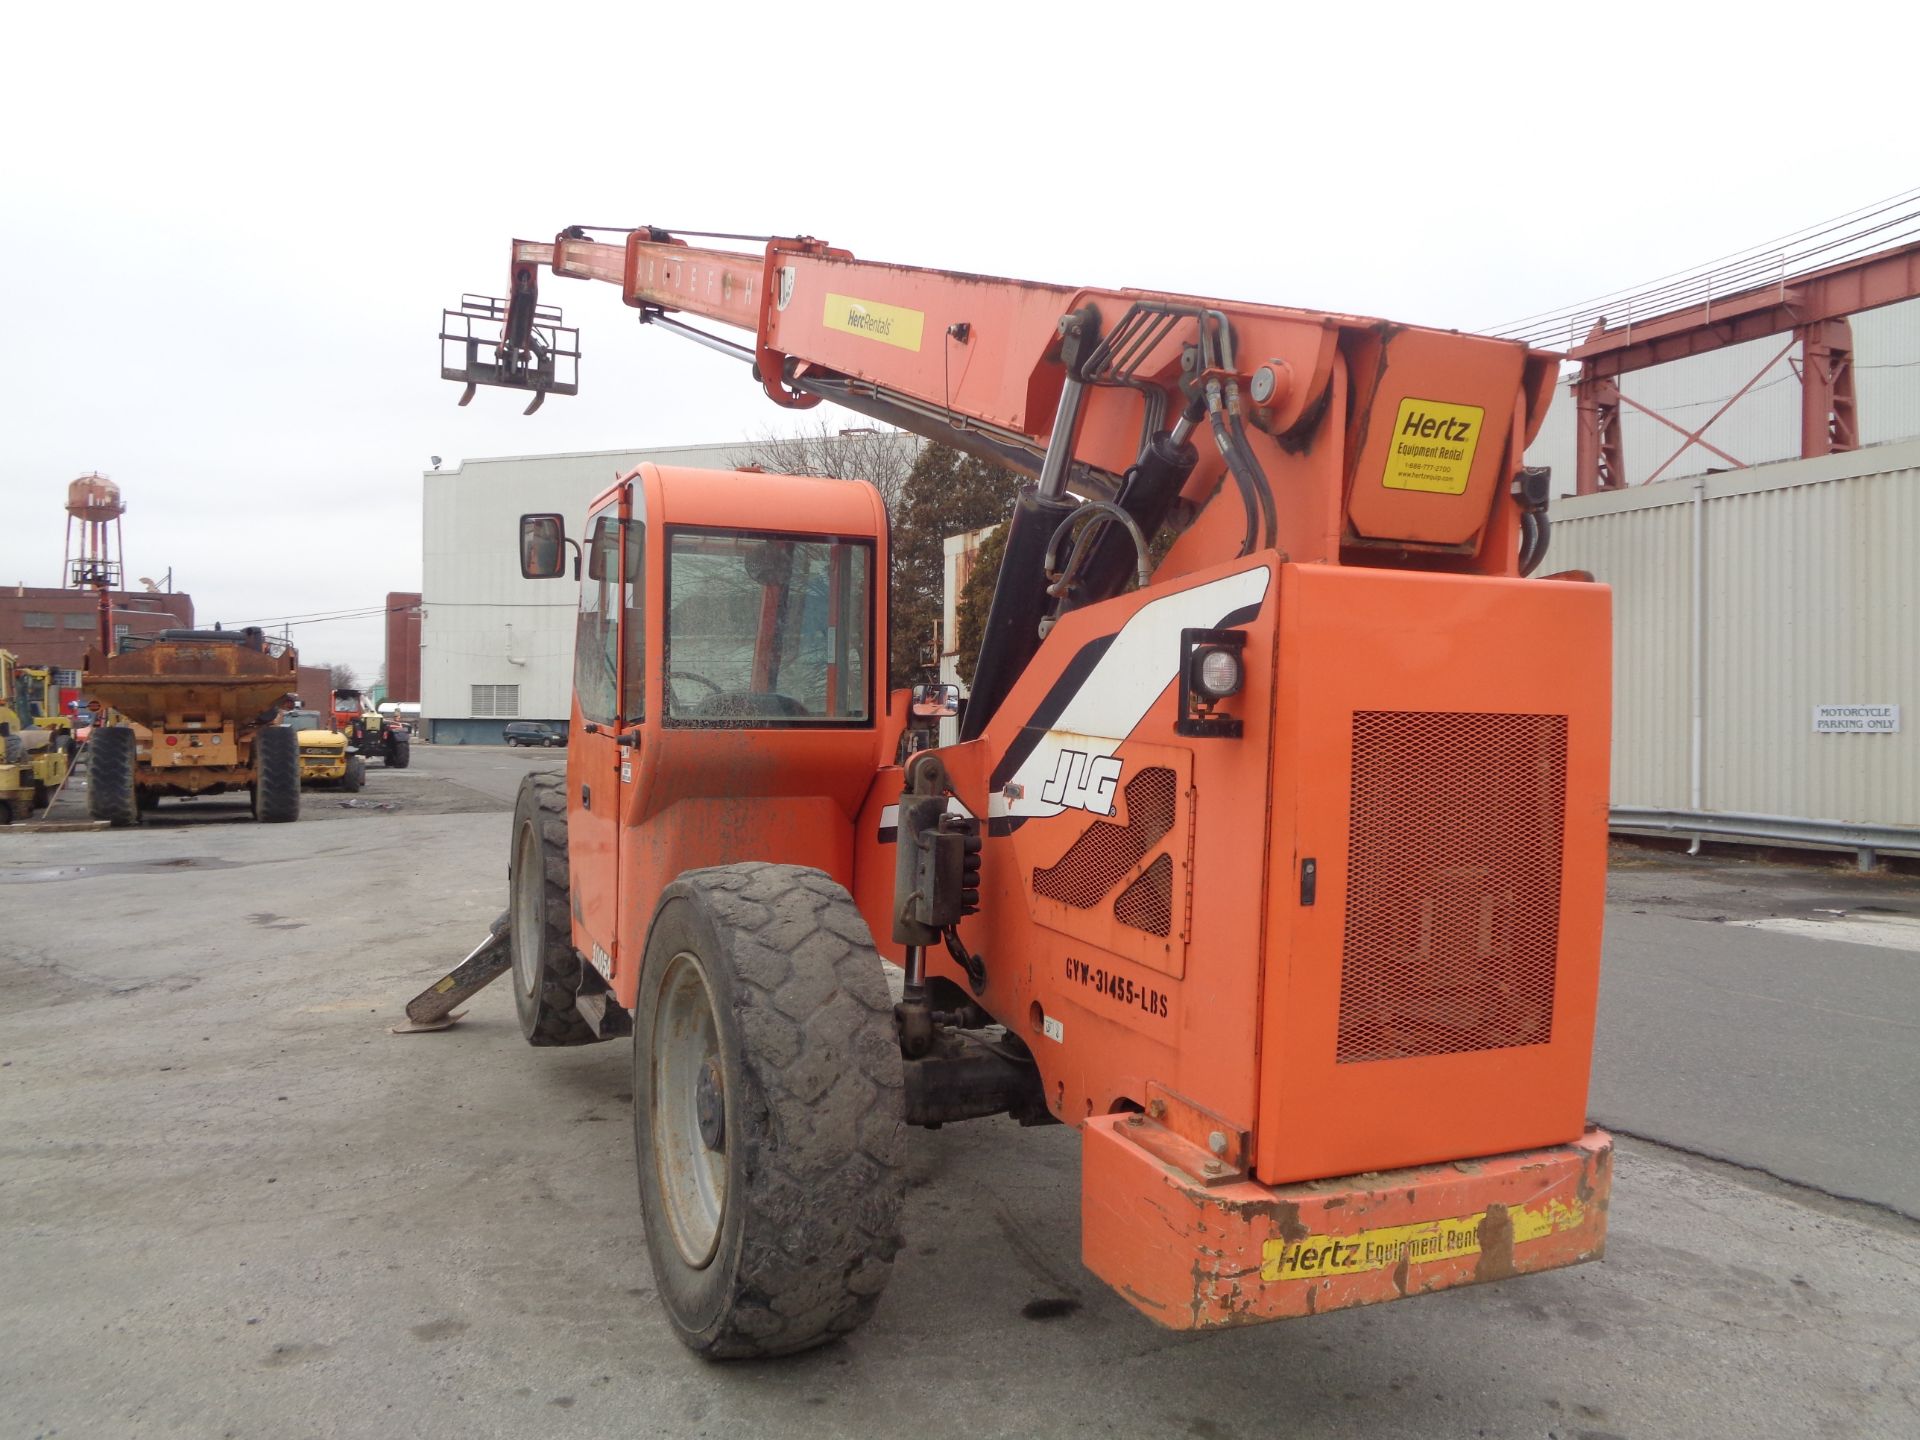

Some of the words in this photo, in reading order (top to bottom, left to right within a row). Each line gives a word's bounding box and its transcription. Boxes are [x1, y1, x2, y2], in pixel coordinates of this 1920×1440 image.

[690, 267, 697, 292] E
[706, 270, 714, 296] F
[744, 277, 754, 305] H
[1403, 411, 1471, 442] Hertz
[1397, 442, 1438, 458] Equipment
[1438, 447, 1464, 461] Rental
[1817, 719, 1864, 729] PARKING
[1867, 719, 1895, 729] ONLY
[1821, 708, 1891, 717] MOTORCYCLE
[1041, 749, 1124, 816] JLG
[1277, 1241, 1360, 1273] Hertz
